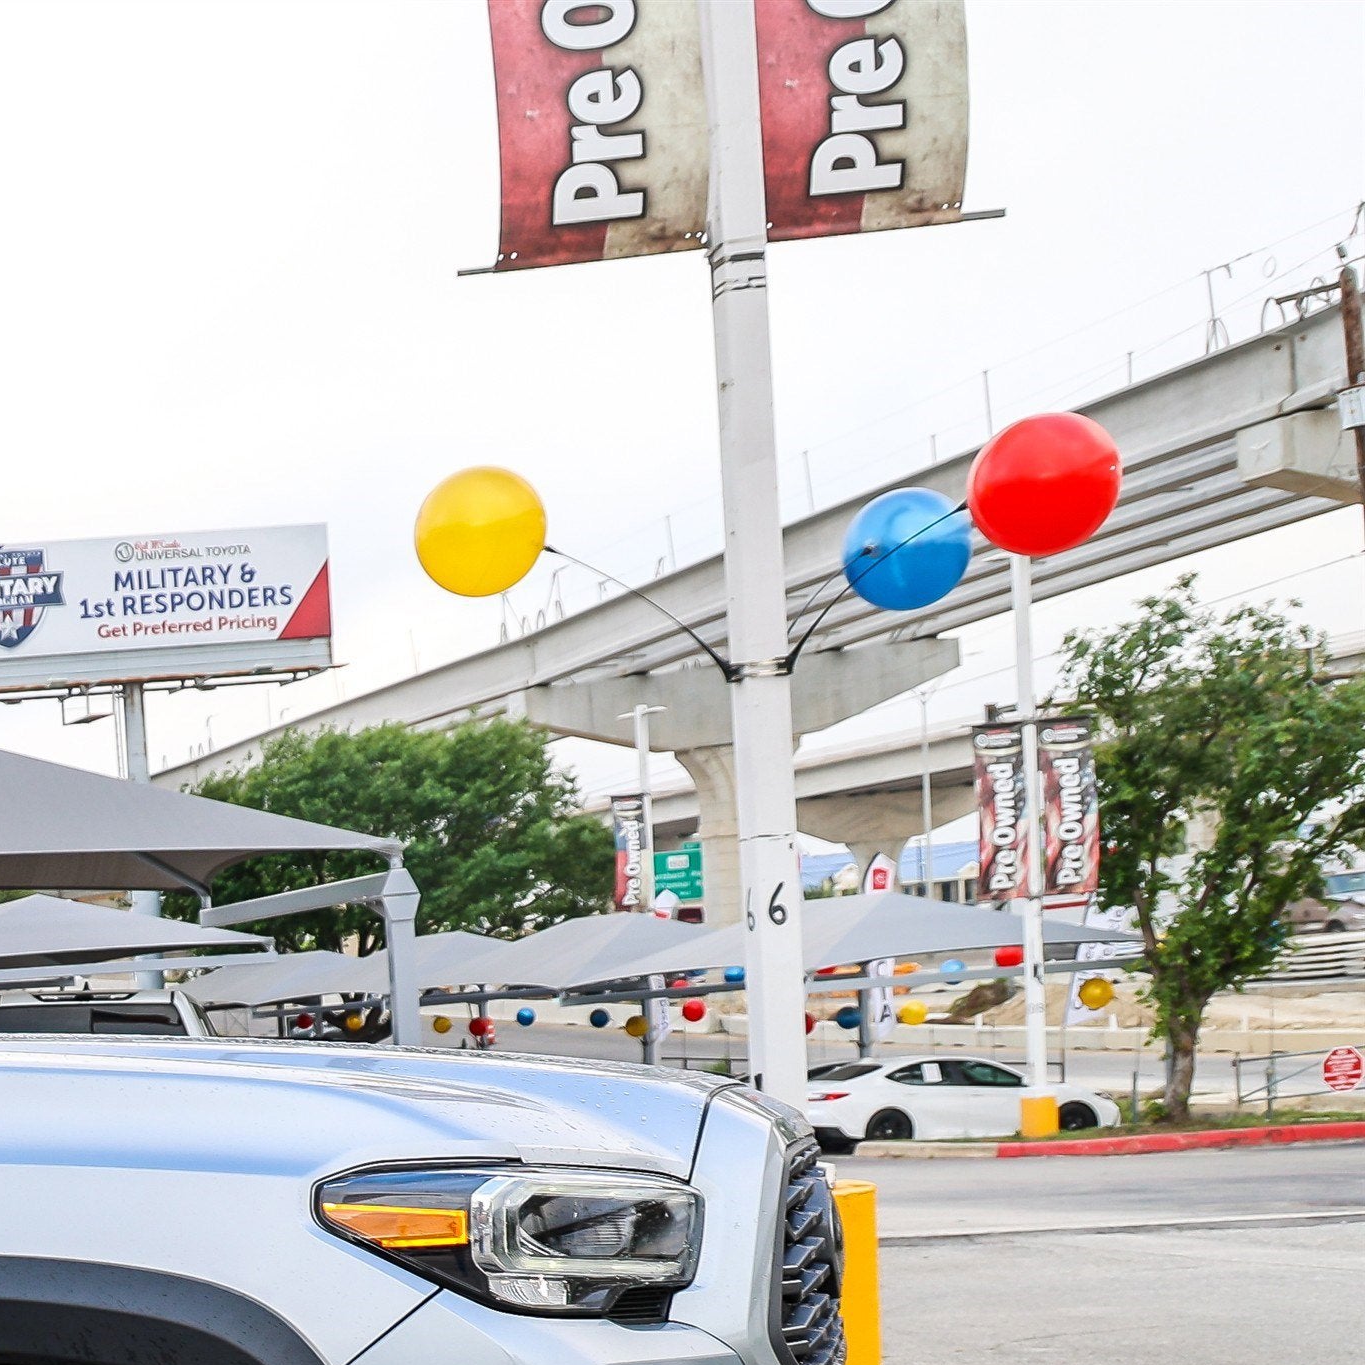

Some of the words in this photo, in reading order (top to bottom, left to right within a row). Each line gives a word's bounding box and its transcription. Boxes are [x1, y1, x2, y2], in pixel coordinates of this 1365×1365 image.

[808, 37, 906, 197] Pre
[551, 66, 647, 226] Pre
[135, 546, 203, 561] UNIVERSAL
[205, 544, 251, 558] TOYOTA
[113, 563, 233, 592] MILITARY
[239, 562, 256, 583] &
[80, 597, 114, 619] 1st
[122, 584, 294, 616] RESPONDERS
[97, 624, 128, 639] Get
[132, 617, 214, 636] Preferred
[218, 613, 279, 632] Pricing
[986, 762, 1018, 847] Owned
[1052, 757, 1085, 841] Owned
[988, 849, 1017, 892] Pre
[1055, 844, 1084, 886] Pre
[621, 878, 642, 907] Pre
[768, 881, 789, 926] 6
